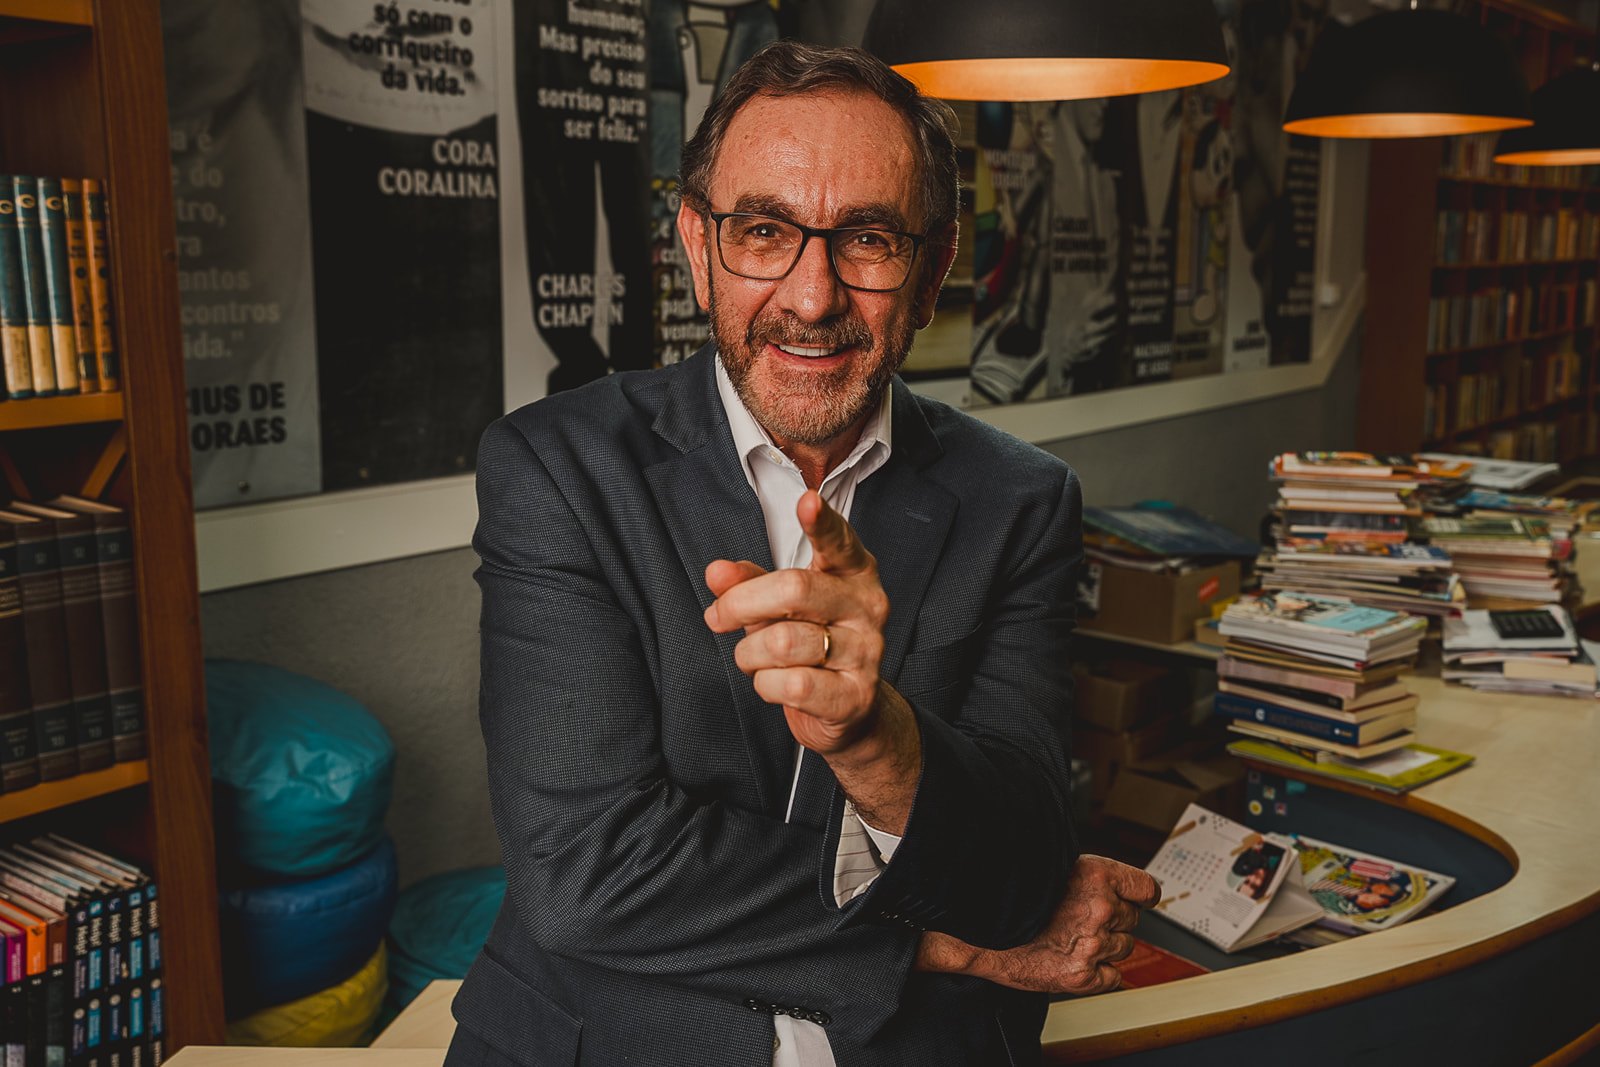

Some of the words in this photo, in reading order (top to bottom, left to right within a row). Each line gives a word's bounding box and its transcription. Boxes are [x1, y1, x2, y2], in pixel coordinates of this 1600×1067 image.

[374, 1, 400, 25] só
[407, 9, 454, 33] com
[459, 16, 473, 36] o
[349, 31, 474, 68] corriqueiro
[539, 25, 577, 52] Mas
[582, 35, 645, 61] preciso
[381, 62, 408, 91] da
[589, 61, 611, 85] do
[616, 70, 645, 90] seu
[538, 87, 603, 112] sorriso
[608, 96, 646, 118] para
[564, 118, 592, 138] ser
[432, 138, 496, 167] CORA
[189, 158, 224, 188] do
[377, 167, 497, 198] CORALINA
[176, 197, 227, 228] tro,
[178, 268, 252, 291] antos
[537, 273, 625, 297] CHARS
[181, 301, 281, 325] contros
[538, 303, 624, 328] CHAPN
[187, 384, 241, 416] IUS
[249, 382, 286, 411] DE
[190, 416, 288, 452] ORAES
